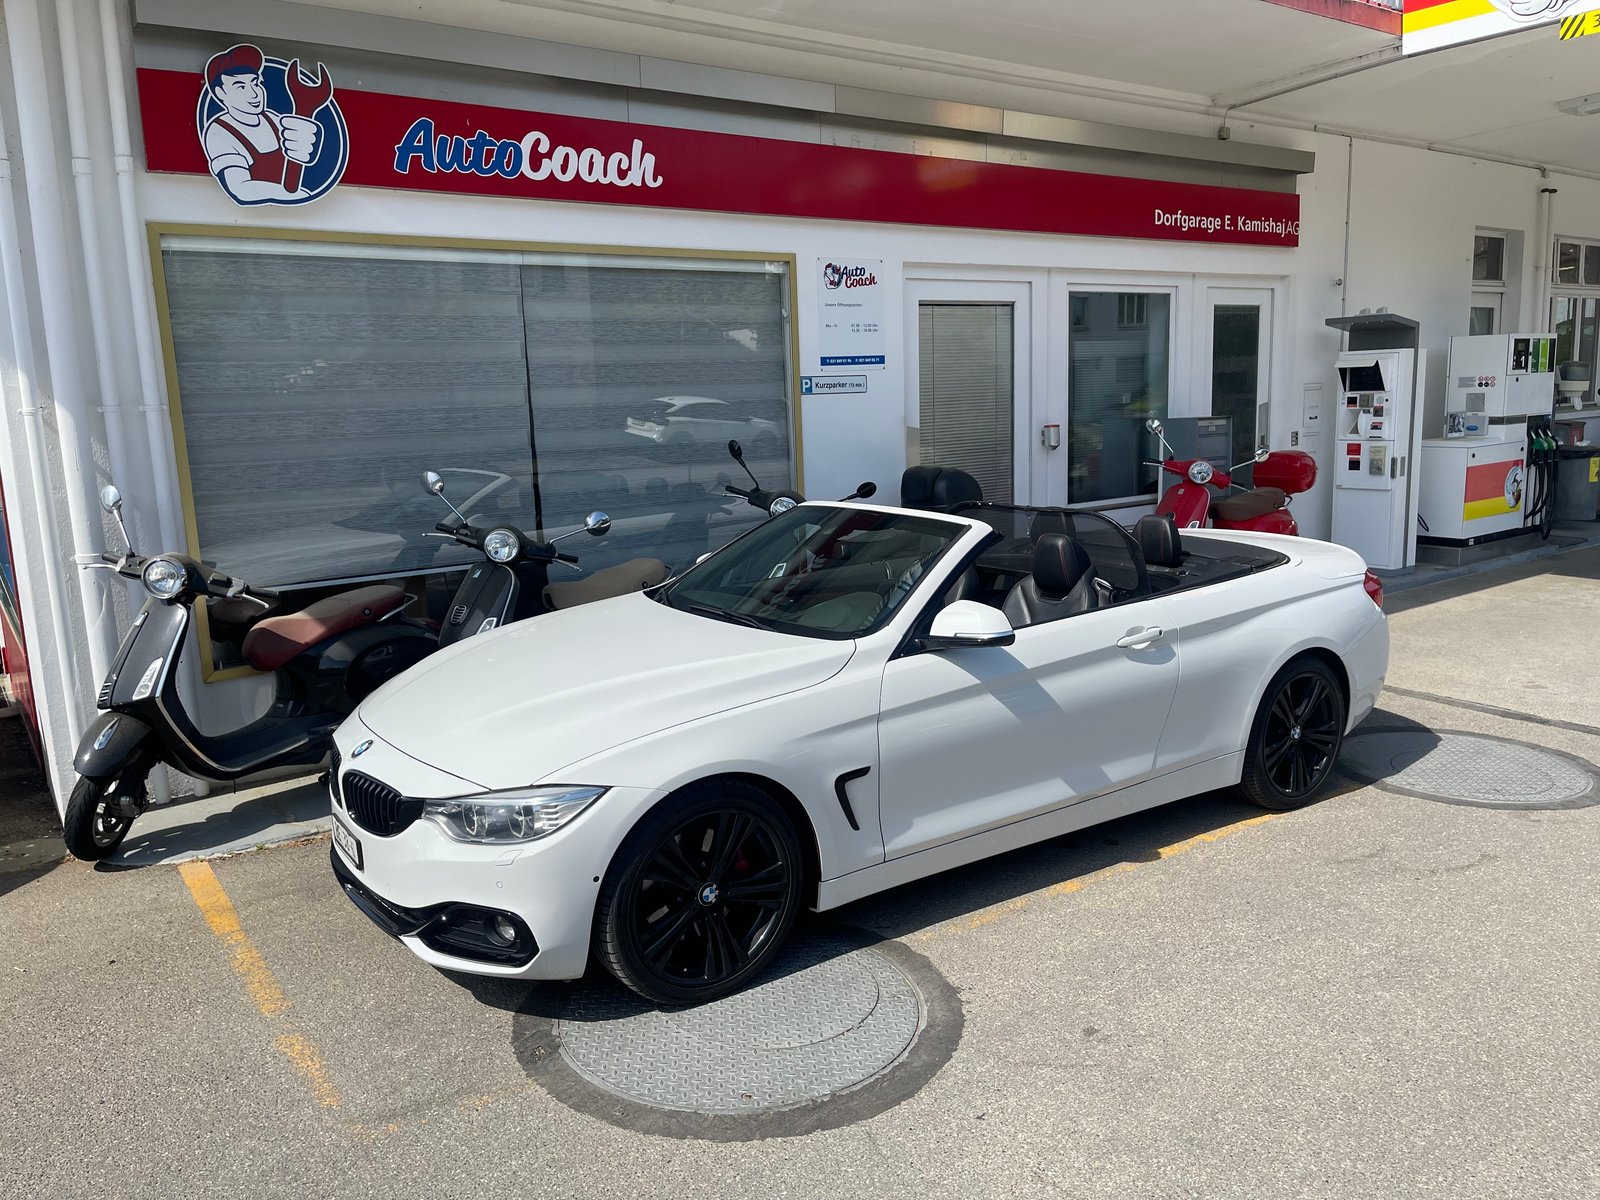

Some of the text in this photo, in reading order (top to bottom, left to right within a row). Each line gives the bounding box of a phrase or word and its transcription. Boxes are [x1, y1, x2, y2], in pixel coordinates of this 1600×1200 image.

[1154, 209, 1221, 233] Dorfgarage
[1224, 215, 1234, 231] E.
[841, 265, 866, 279] Auto
[845, 272, 877, 288] Coach
[802, 379, 811, 392] P
[815, 381, 848, 390] Kurzparker
